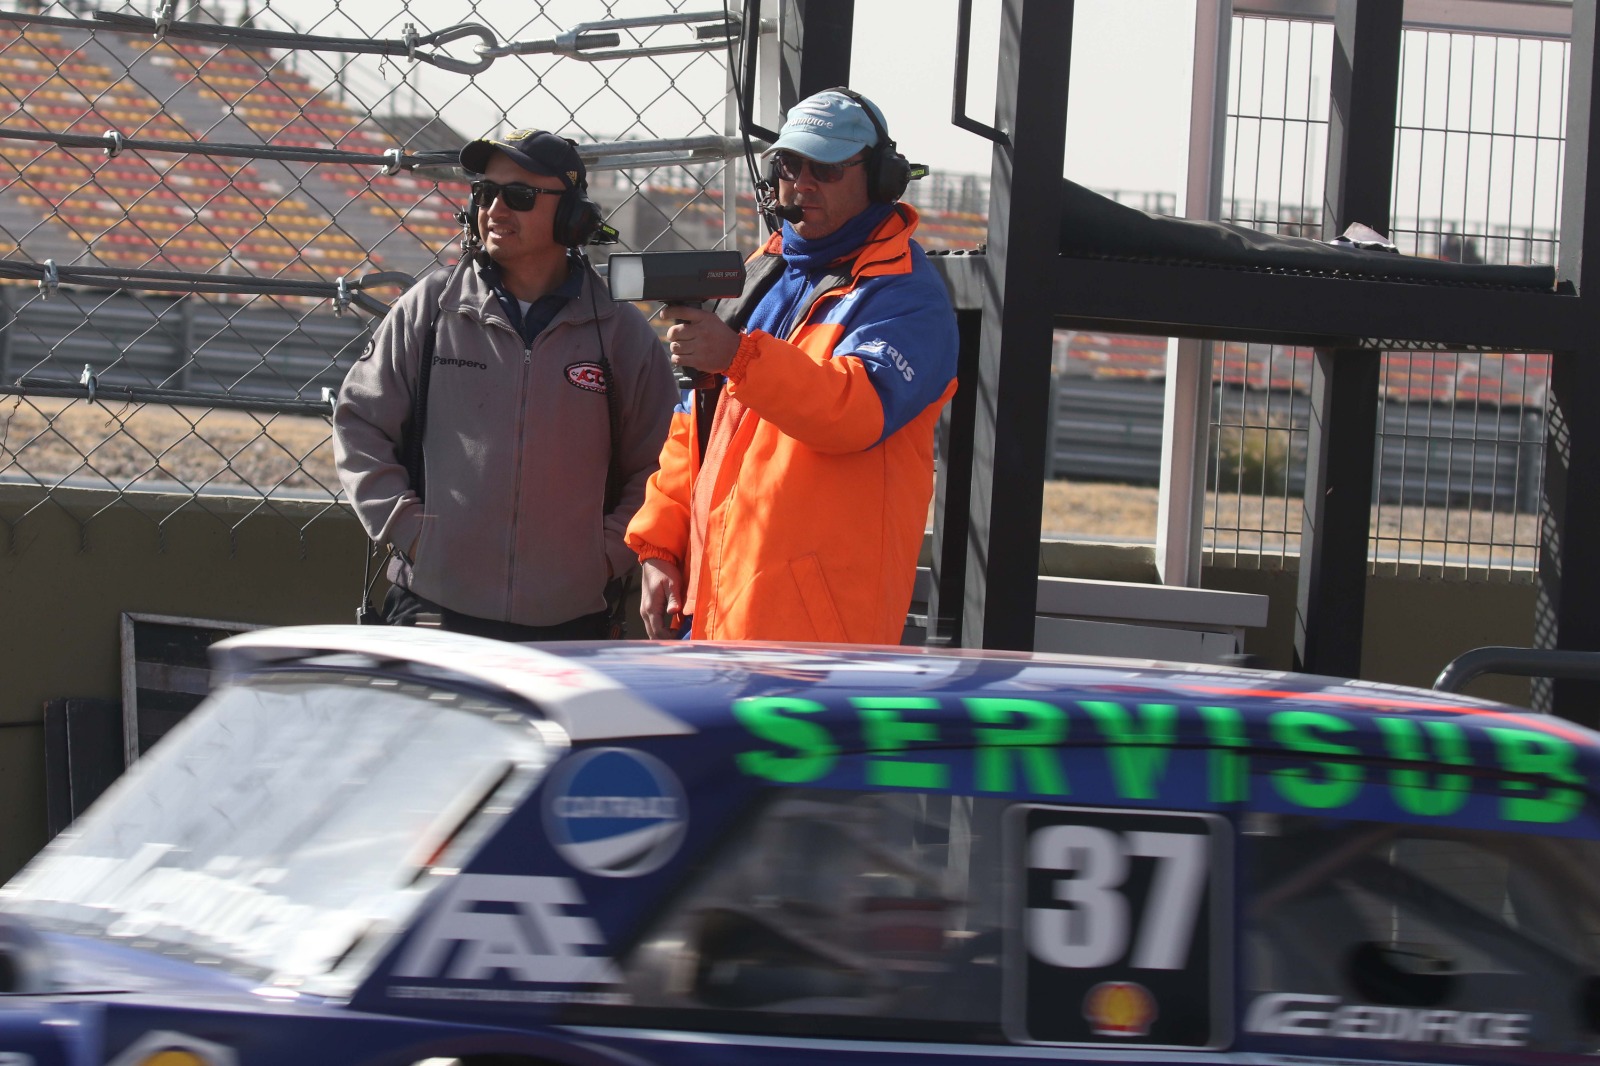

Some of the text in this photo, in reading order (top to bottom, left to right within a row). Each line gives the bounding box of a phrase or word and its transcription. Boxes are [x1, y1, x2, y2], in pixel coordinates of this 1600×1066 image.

[432, 356, 488, 370] Pampero
[886, 345, 915, 382] RUS
[1027, 825, 1210, 970] 37
